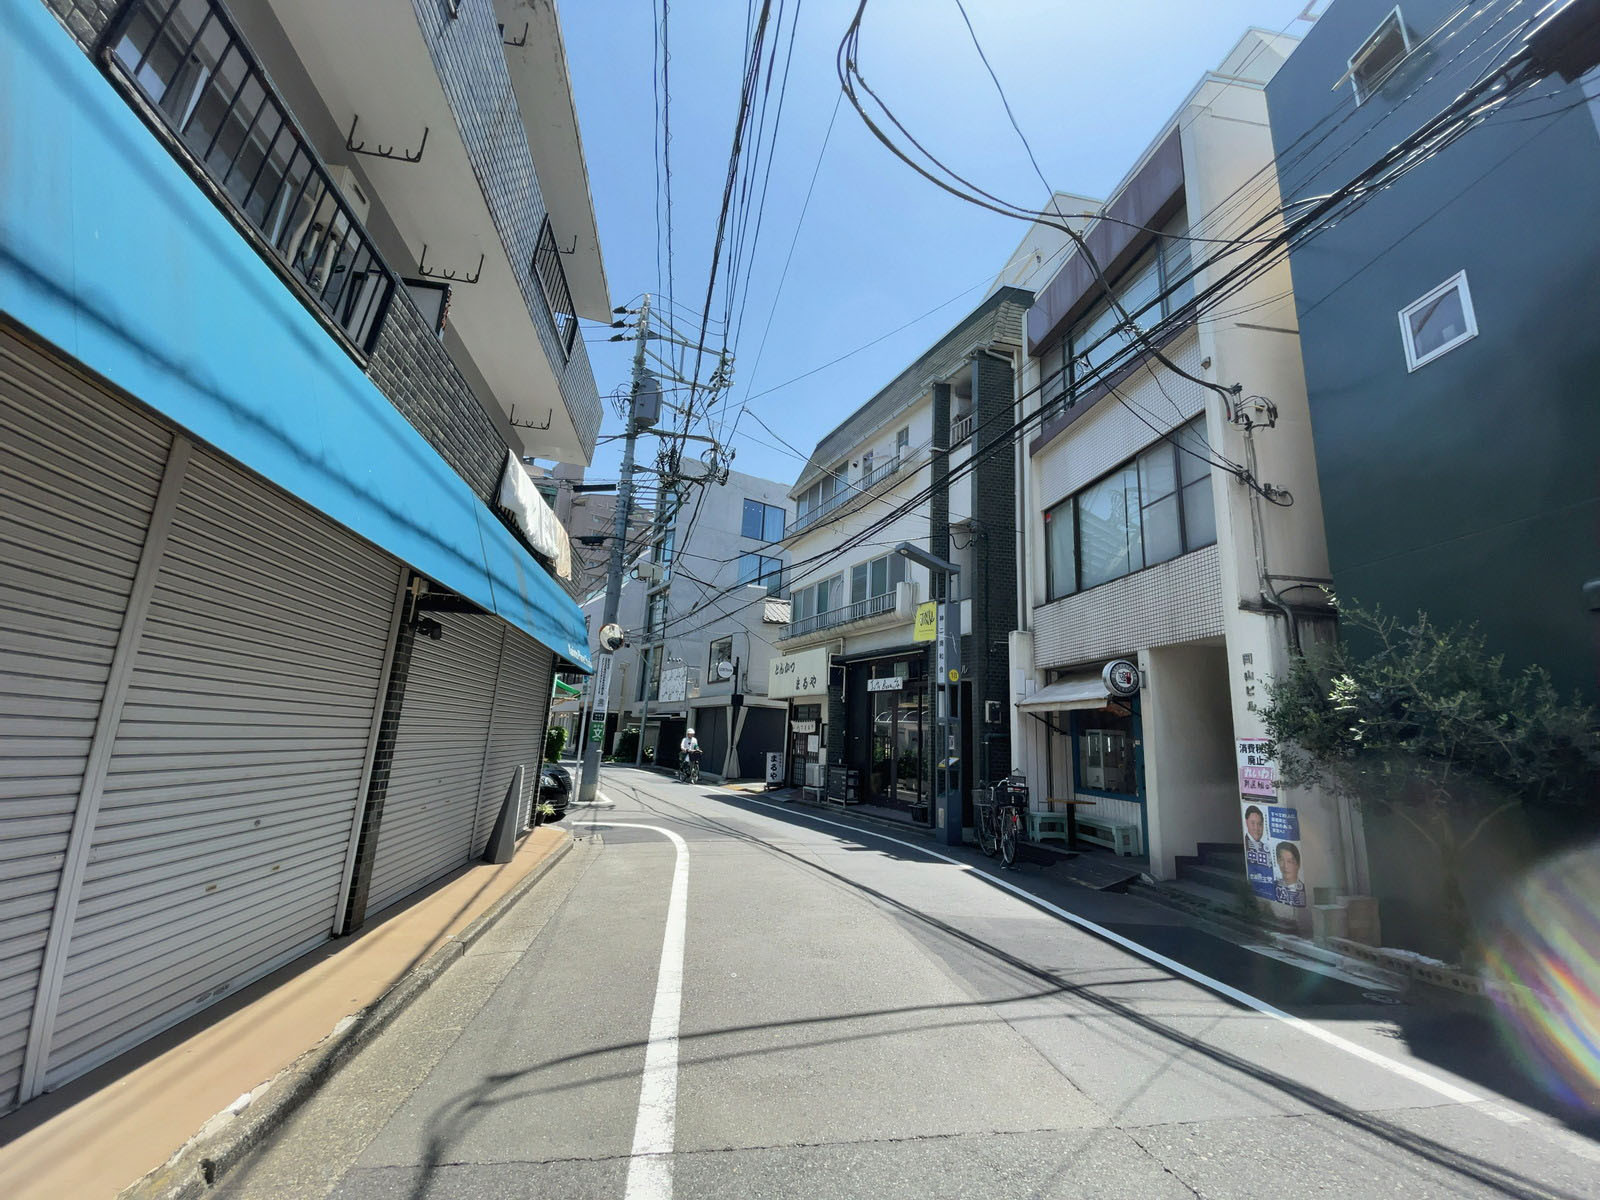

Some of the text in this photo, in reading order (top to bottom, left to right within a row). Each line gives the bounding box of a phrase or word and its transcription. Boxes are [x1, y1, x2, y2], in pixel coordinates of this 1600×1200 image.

[775, 662, 796, 675] とんかつ
[795, 675, 817, 690] まるや
[592, 727, 603, 738] 文
[1247, 755, 1265, 766] 廃止
[770, 755, 778, 780] まるや
[1243, 767, 1270, 779] れいわ
[1247, 850, 1268, 866] 中田
